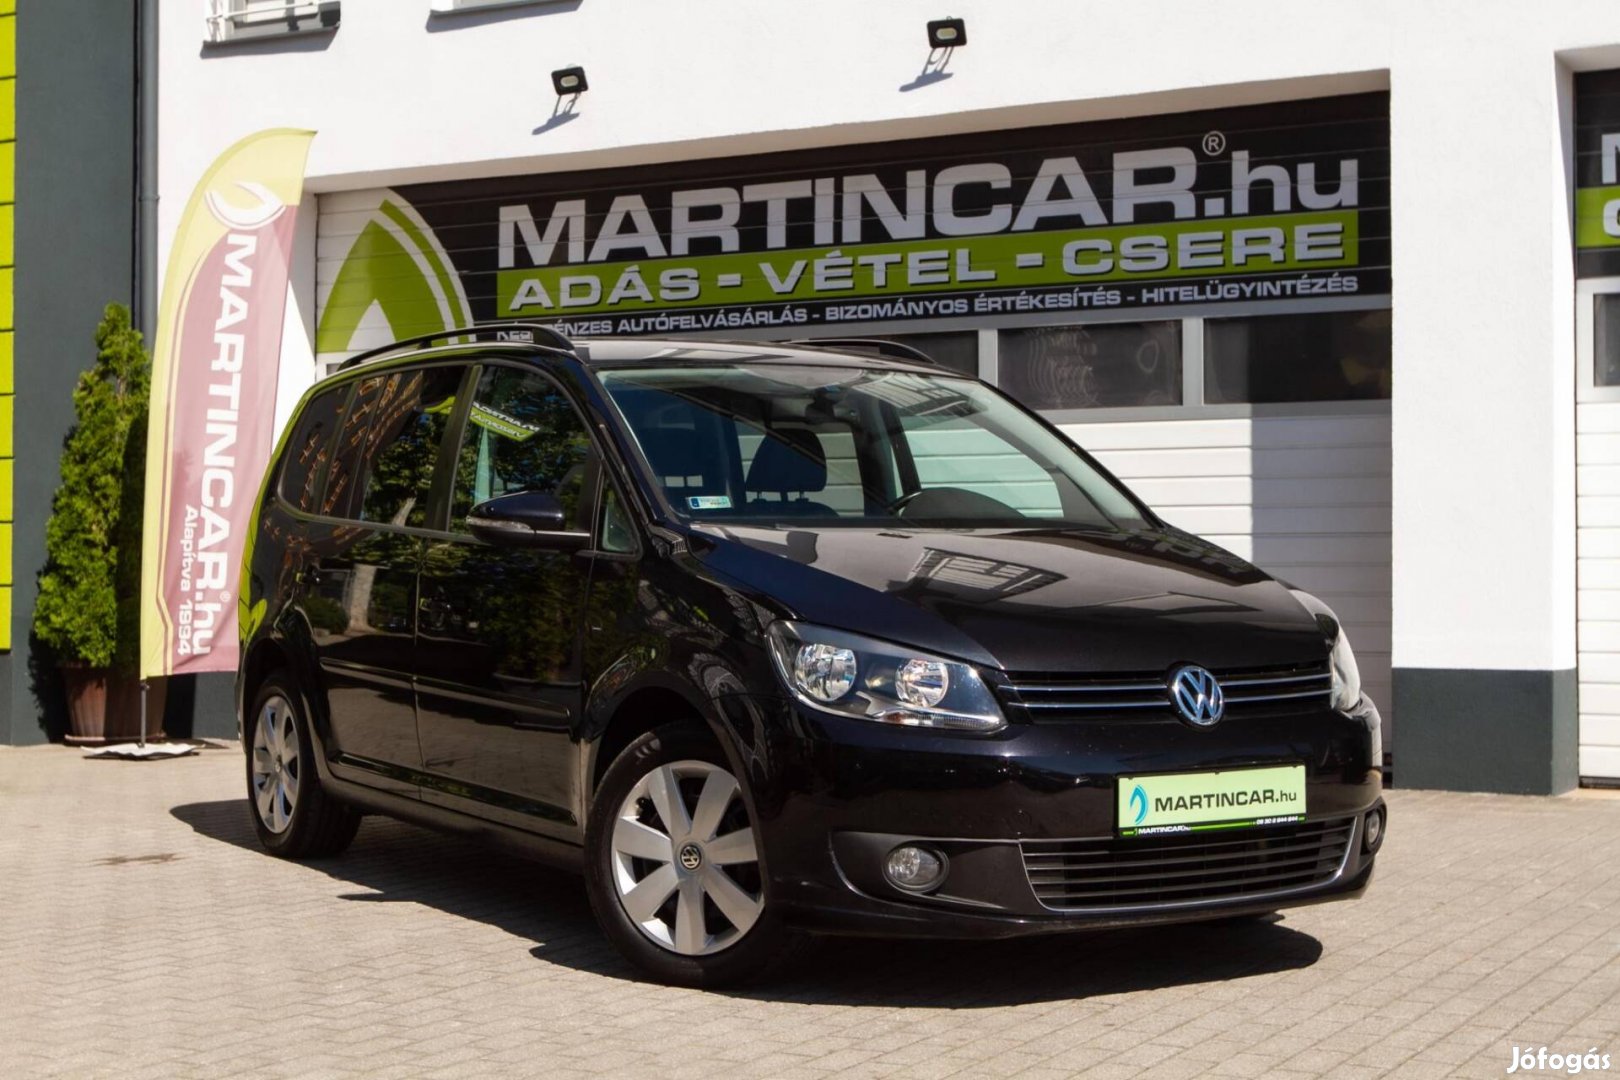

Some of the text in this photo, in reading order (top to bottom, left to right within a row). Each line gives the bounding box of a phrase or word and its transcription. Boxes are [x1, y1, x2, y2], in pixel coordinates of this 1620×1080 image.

[509, 265, 700, 311] ADÁS
[758, 248, 997, 295] VÉTEL
[1062, 222, 1345, 276] CSERE
[617, 305, 808, 334] AUTÓFELVÁSÁRLÁS
[825, 298, 969, 322] BIZOMÁNYOS
[974, 286, 1122, 312] ÉRTÉKESÍTÉS
[1142, 272, 1359, 304] HITELÜGYINTÉZÉS
[180, 504, 199, 592] Alapítva
[1154, 789, 1297, 812] MARTINCAR.hu
